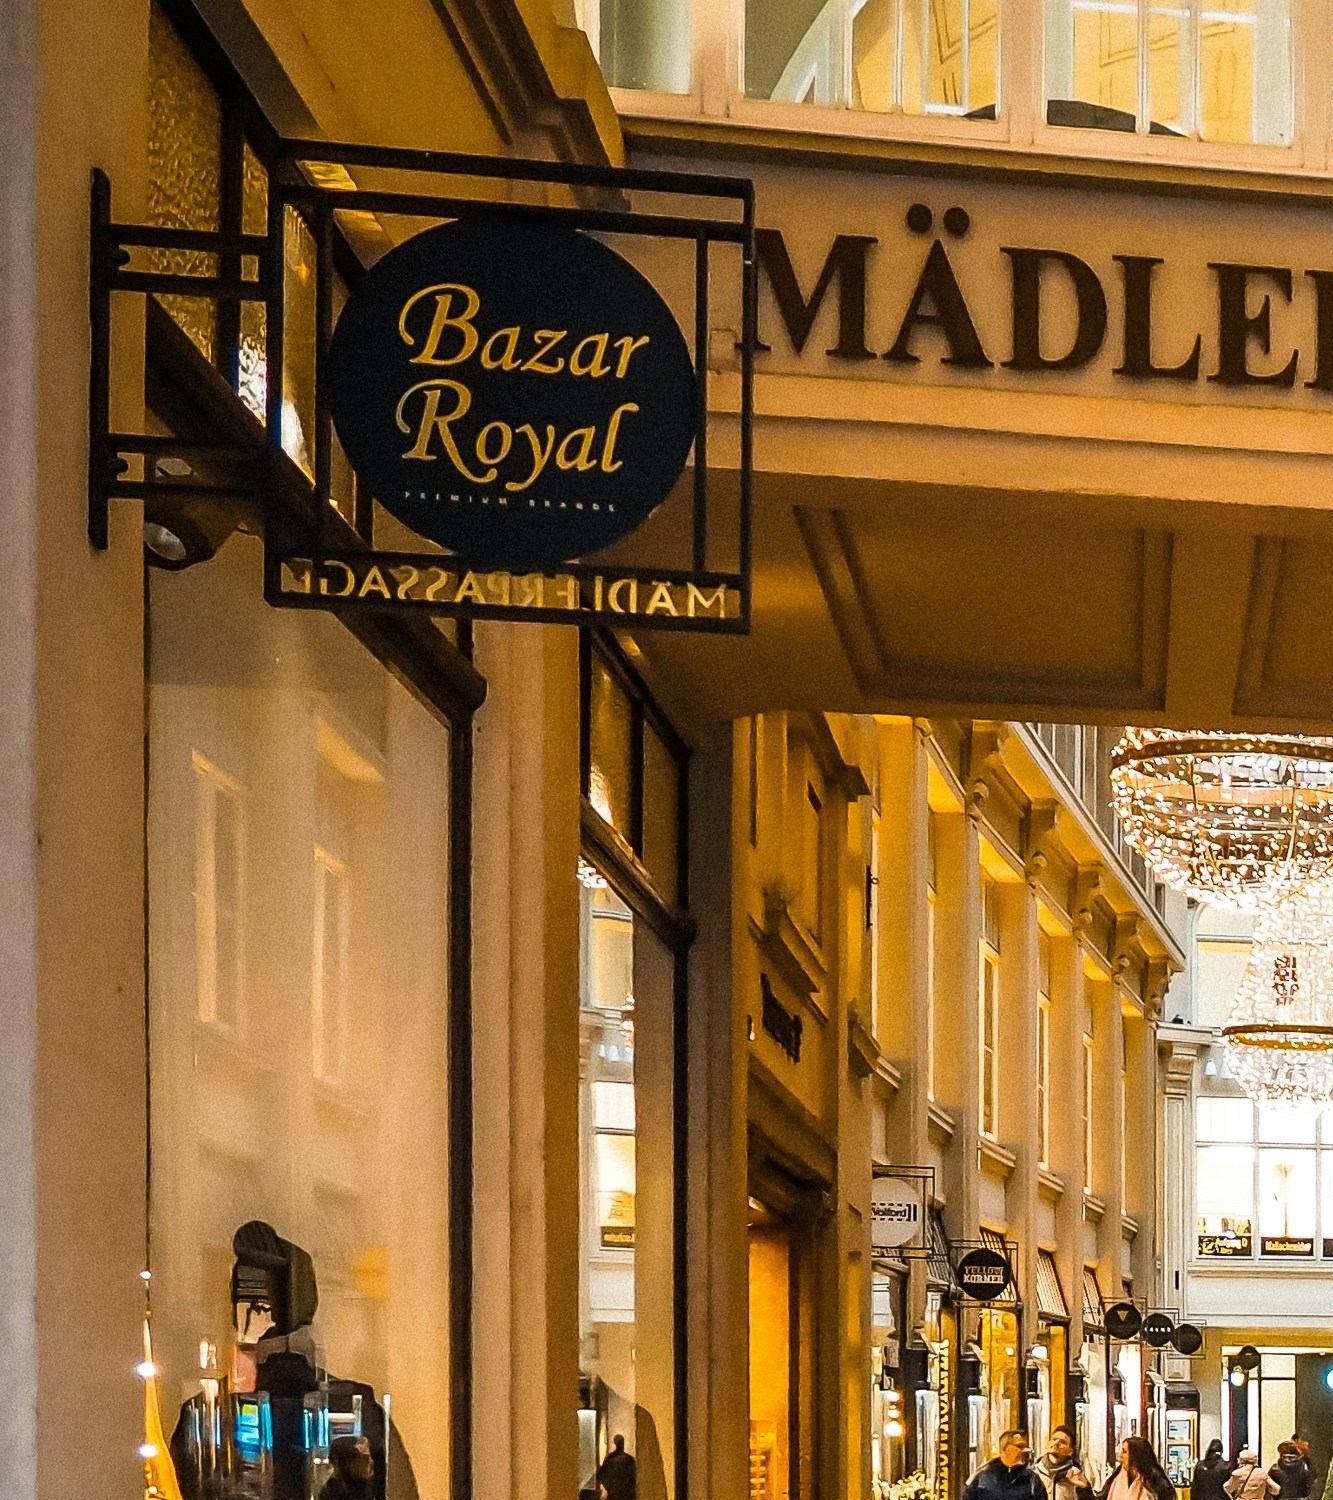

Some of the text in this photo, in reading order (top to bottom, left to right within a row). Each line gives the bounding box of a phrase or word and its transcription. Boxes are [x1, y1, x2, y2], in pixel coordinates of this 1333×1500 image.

[398, 283, 650, 378] Bazar
[396, 378, 640, 491] Royal
[405, 491, 508, 506] PREMIUM
[963, 1265, 1004, 1274] YELLOW
[963, 1274, 1005, 1284] KORNER
